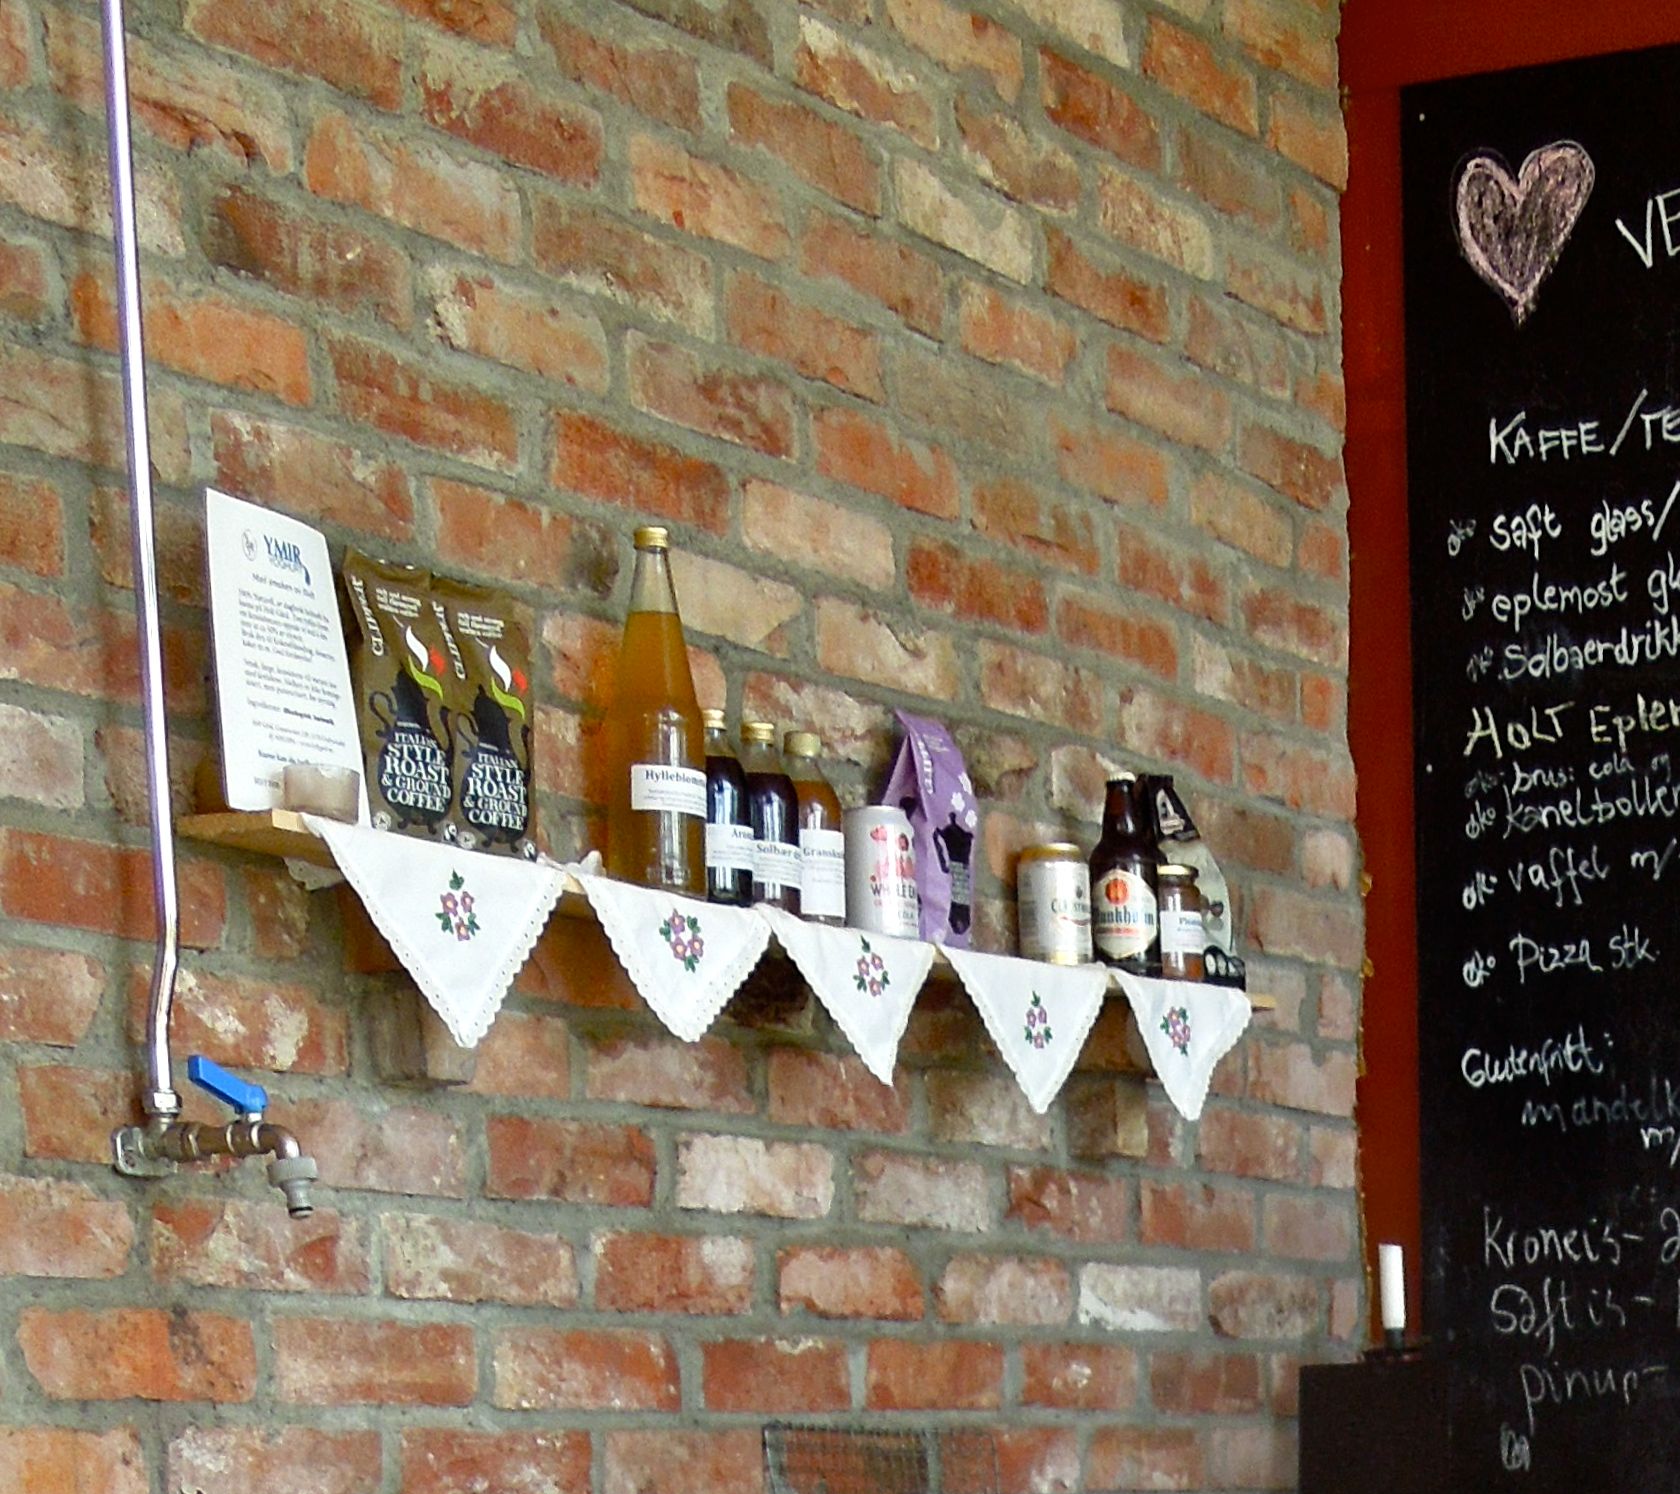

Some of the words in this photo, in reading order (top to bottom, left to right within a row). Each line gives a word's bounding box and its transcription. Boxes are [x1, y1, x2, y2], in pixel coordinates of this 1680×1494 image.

[1490, 503, 1562, 560] saft
[263, 534, 306, 570] YMIR
[1492, 562, 1628, 632] eplemost
[387, 743, 446, 767] STYLE
[384, 754, 449, 786] ROAST
[471, 762, 524, 786] STYLE
[381, 773, 394, 787] &
[395, 775, 452, 799] GROUND
[466, 776, 527, 804] ROAST
[386, 787, 445, 813] COFFEE
[462, 795, 476, 808] &
[478, 799, 528, 818] GROUND
[468, 808, 525, 832] COFFEE
[1508, 843, 1610, 908] vaffel
